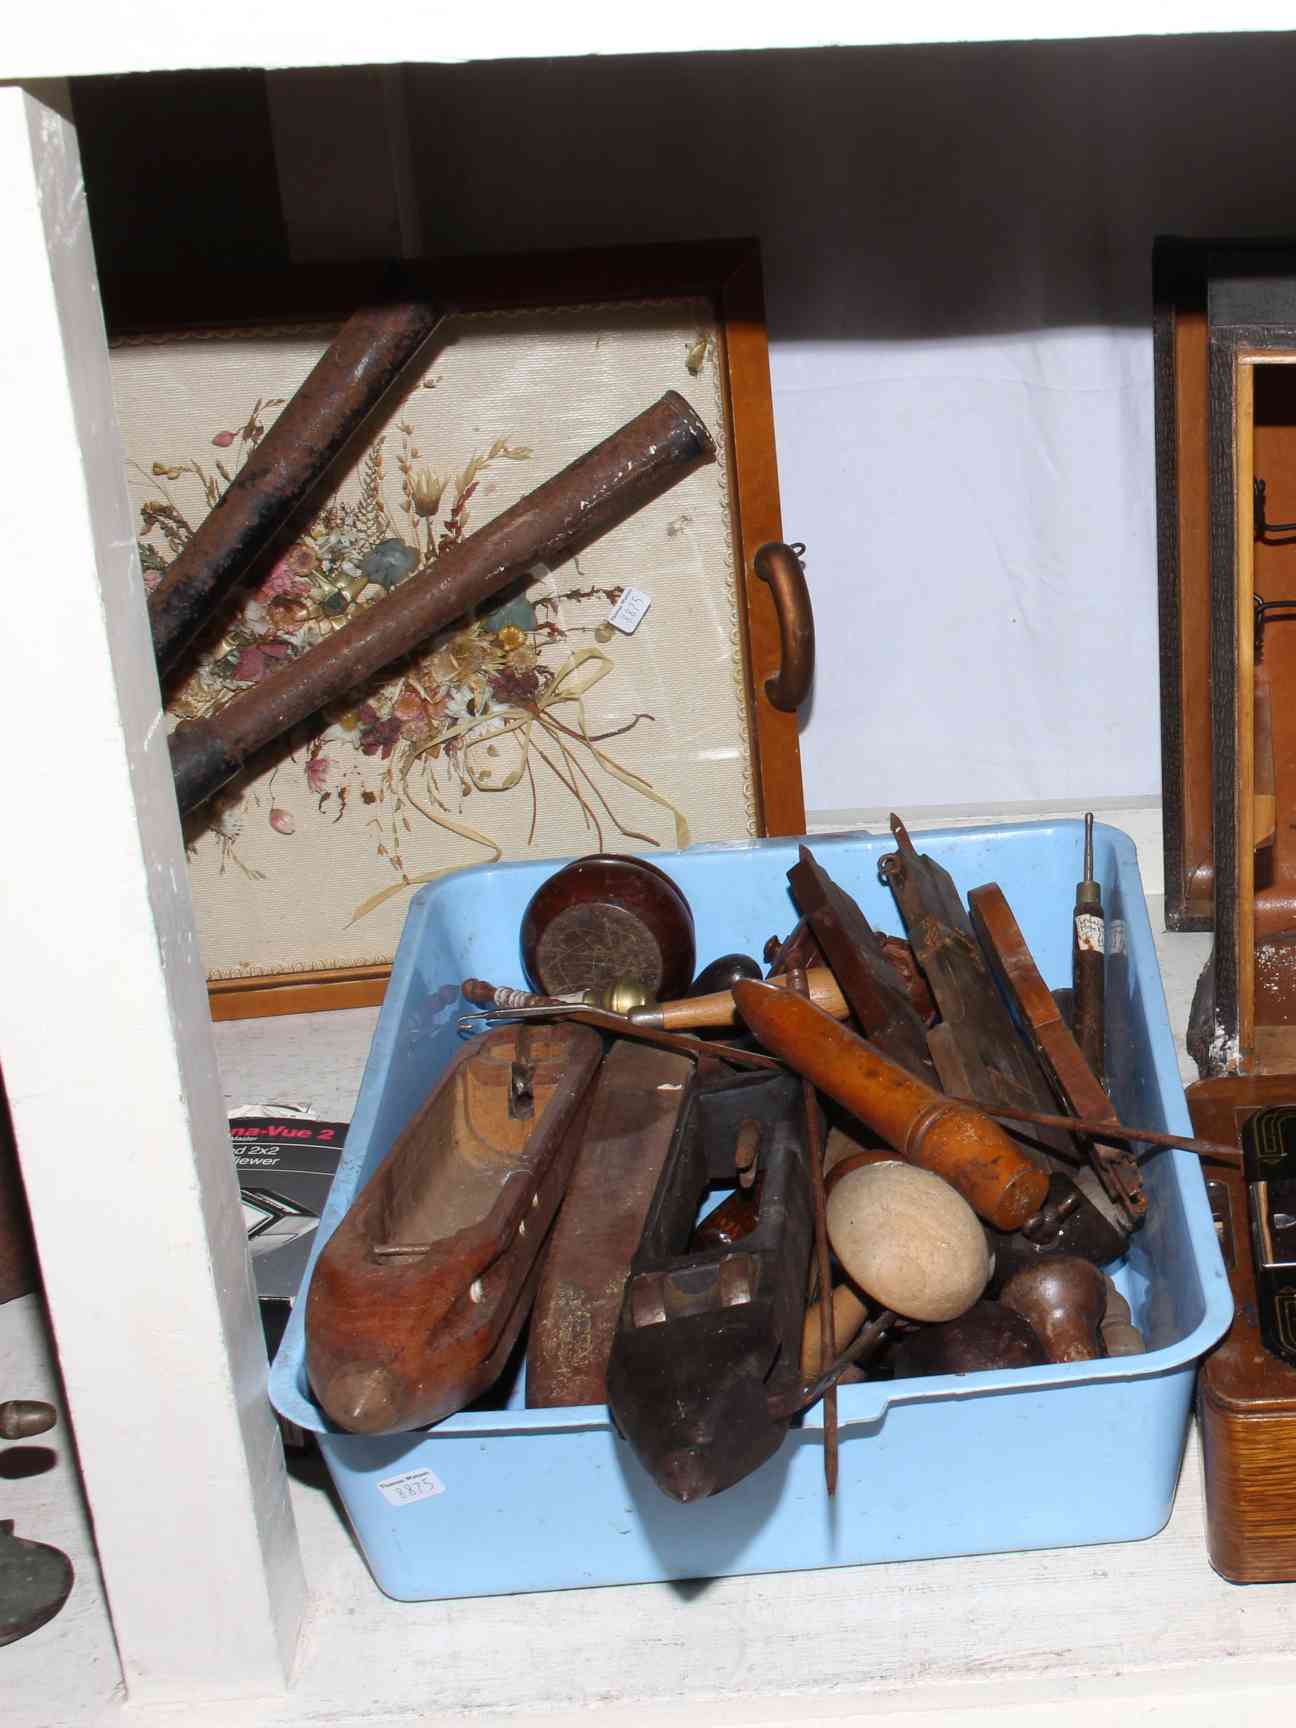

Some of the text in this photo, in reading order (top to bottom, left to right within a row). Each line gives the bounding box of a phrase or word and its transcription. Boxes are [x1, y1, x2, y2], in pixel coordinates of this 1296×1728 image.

[230, 1125, 336, 1141] na-Vue 2
[248, 1145, 281, 1156] 2x2
